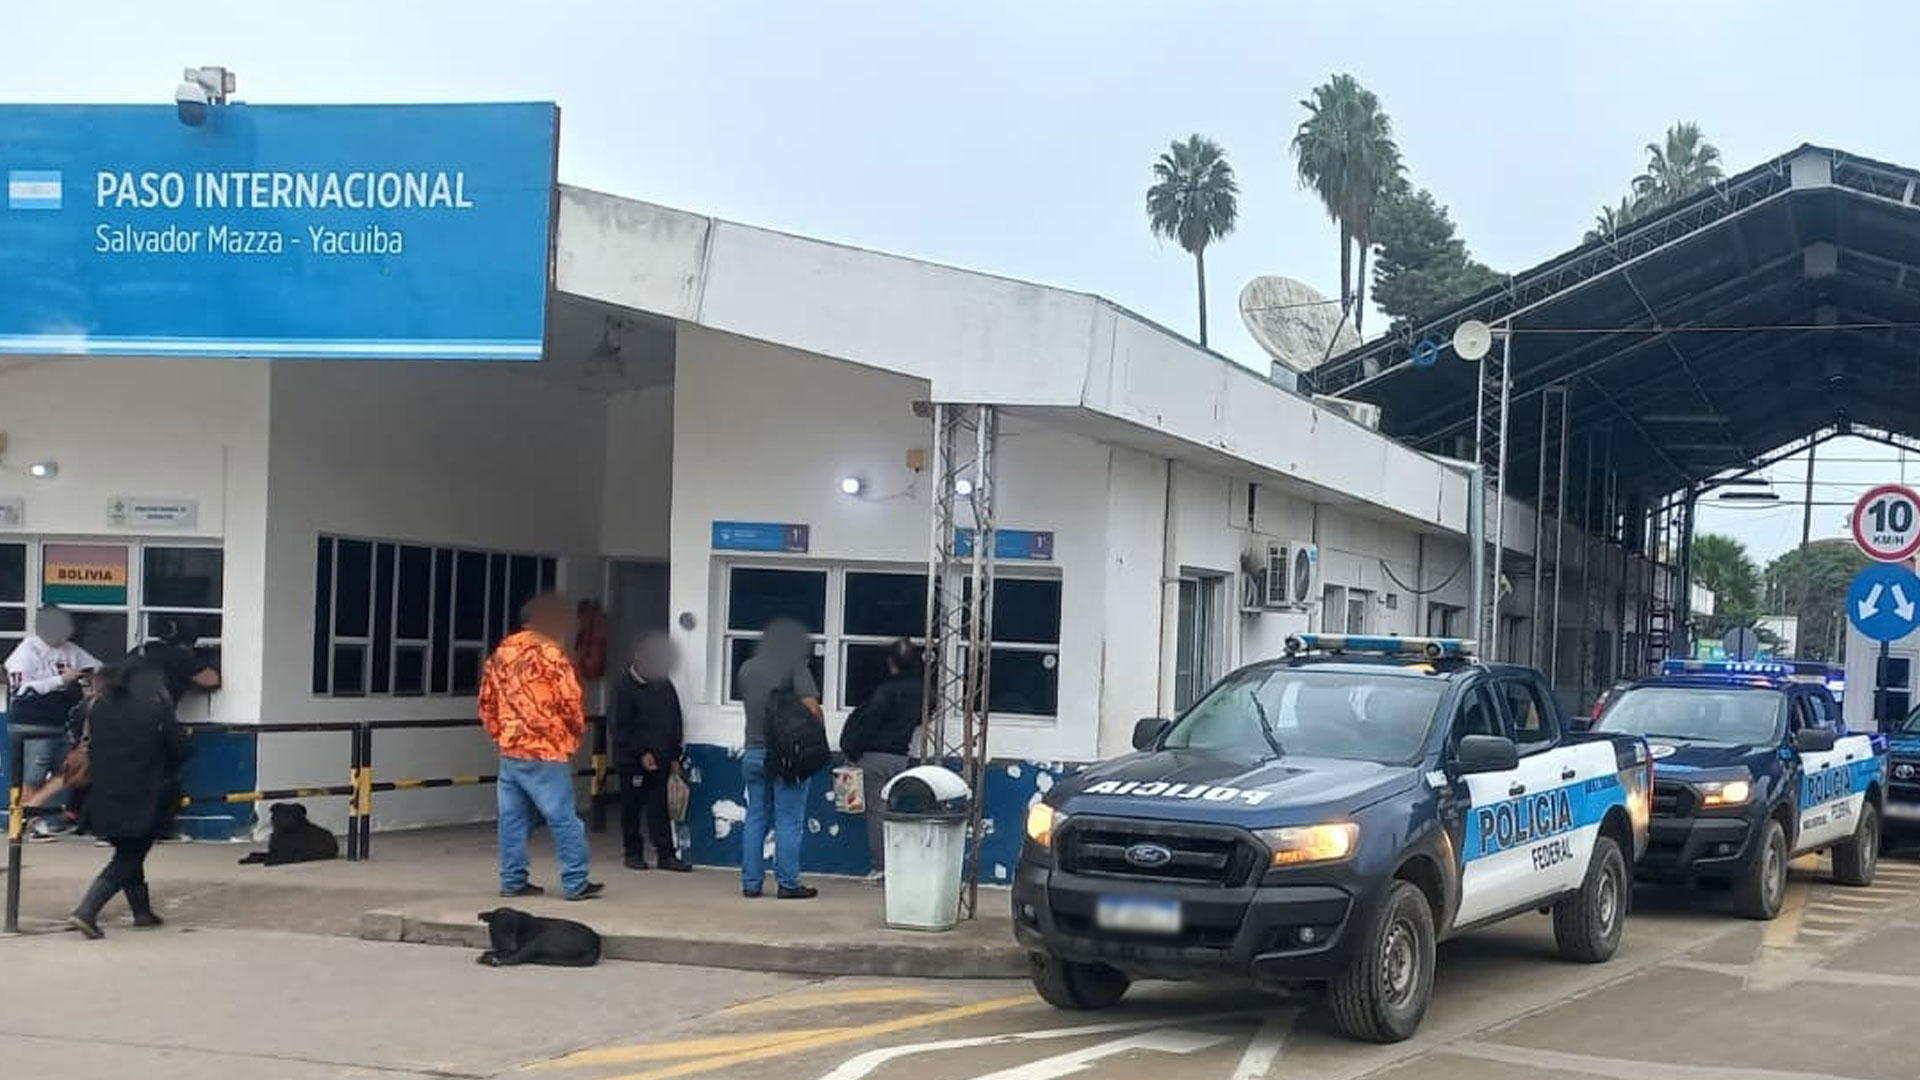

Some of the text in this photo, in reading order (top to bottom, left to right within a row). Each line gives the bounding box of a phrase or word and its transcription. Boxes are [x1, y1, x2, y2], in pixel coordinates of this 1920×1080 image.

[96, 172, 473, 209] PASO INTERNACIONAL
[95, 224, 200, 254] Salvador
[207, 226, 283, 254] Mazza
[307, 225, 403, 255] Yacuiba
[1868, 500, 1913, 532] 10
[1873, 535, 1904, 545] KM/H
[58, 568, 113, 581] BOLIVIA
[1477, 789, 1573, 856] POLICIA
[1531, 838, 1574, 871] FEDERAL
